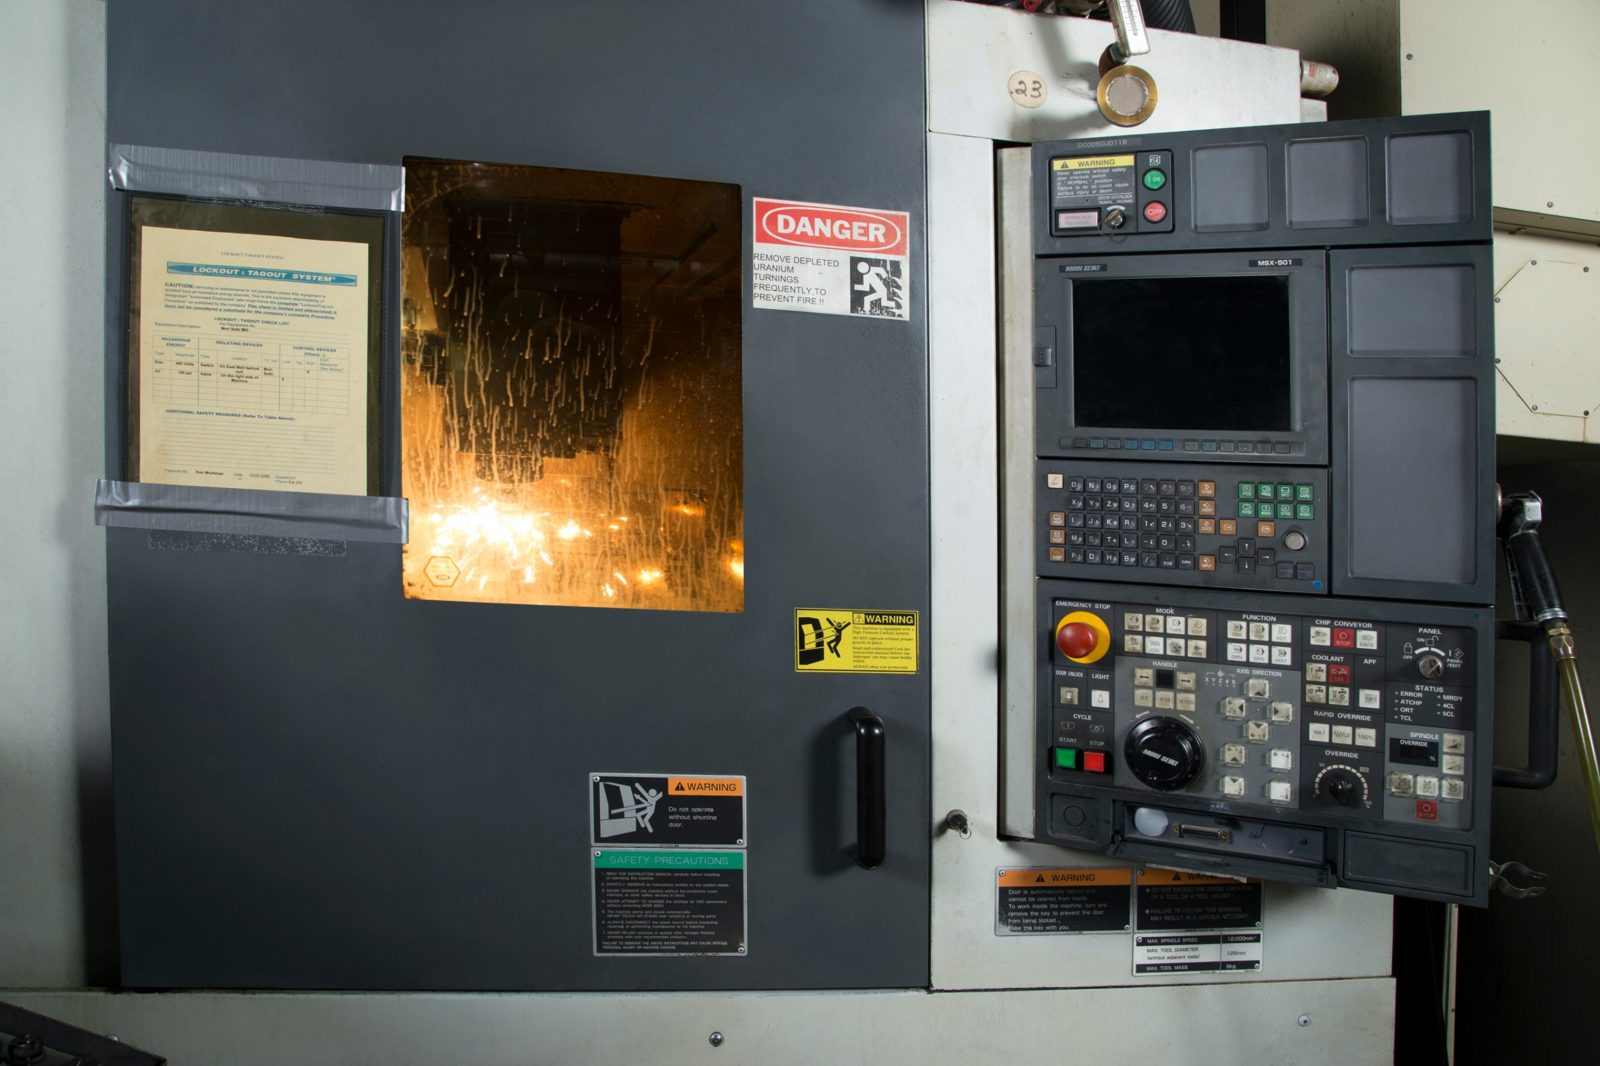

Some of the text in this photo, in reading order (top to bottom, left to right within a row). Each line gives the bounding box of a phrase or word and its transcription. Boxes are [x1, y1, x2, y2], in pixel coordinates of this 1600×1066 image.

[1015, 80, 1042, 98] 23
[1077, 158, 1116, 168] WARNING
[777, 214, 886, 243] DANGER
[753, 253, 839, 268] REMOVE DEPLETED
[753, 264, 794, 274] URANIUM
[193, 267, 333, 282] LOCKOUT TAGOUT SYSTEM
[753, 273, 799, 284] TURNINGS
[165, 281, 194, 289] CAUTION:
[753, 293, 794, 304] PREVENT
[797, 296, 817, 305] FIRE
[1055, 601, 1092, 609] EMERGENCY
[866, 614, 913, 624] WARNING
[1242, 613, 1276, 622] FUNCTION
[1334, 620, 1373, 629] CONVEYOR
[1418, 627, 1442, 635] PANEL
[1415, 685, 1443, 693] STATUS
[1314, 710, 1372, 722] RAPID OVERRIDE
[1410, 732, 1440, 740] SPINDLE
[1325, 750, 1359, 759] OVERRIDE
[687, 783, 737, 792] WARNING
[609, 856, 729, 865] SAFETY PRECAUTIONS
[1051, 873, 1096, 882] WARNING
